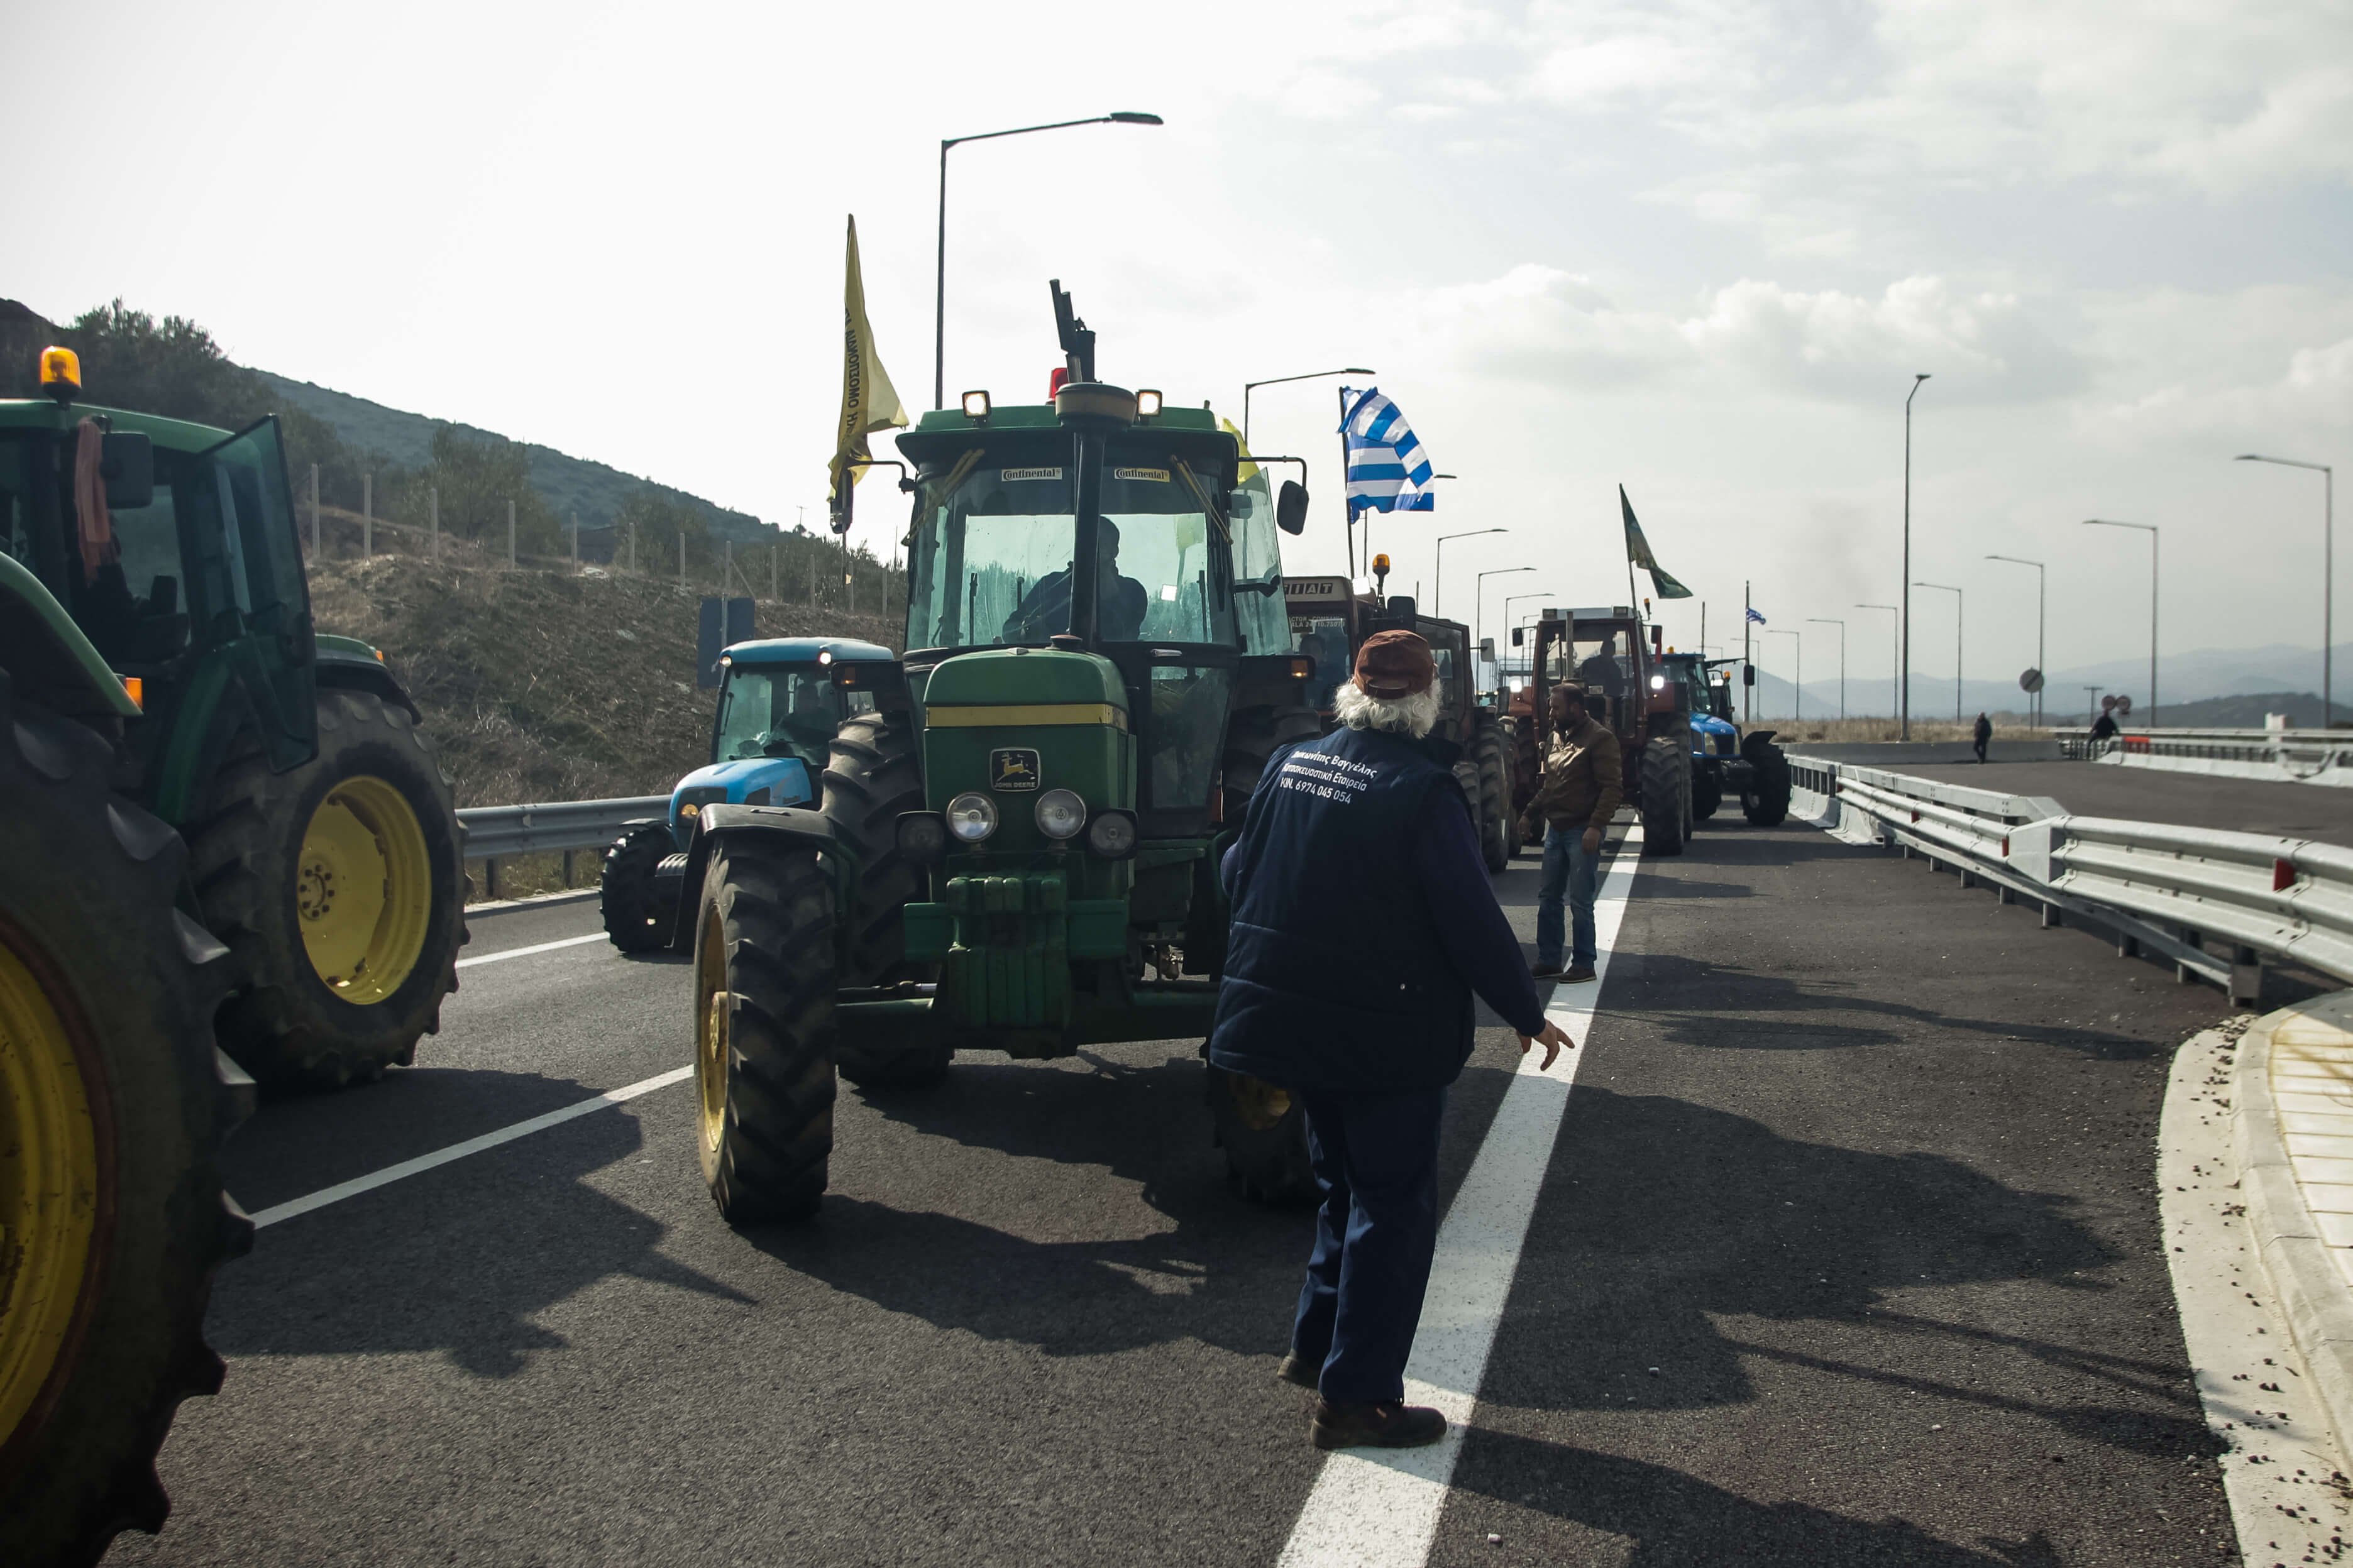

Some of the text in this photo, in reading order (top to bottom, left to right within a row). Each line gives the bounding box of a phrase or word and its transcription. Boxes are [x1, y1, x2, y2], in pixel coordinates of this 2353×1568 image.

[1003, 468, 1055, 480] Continental
[1116, 468, 1164, 480] Continental
[1330, 755, 1377, 779] Βαγγέλης
[1332, 772, 1368, 791] Εταιρεία
[1295, 780, 1316, 795] 6974
[1316, 785, 1333, 798] 045
[1333, 789, 1352, 804] 054
